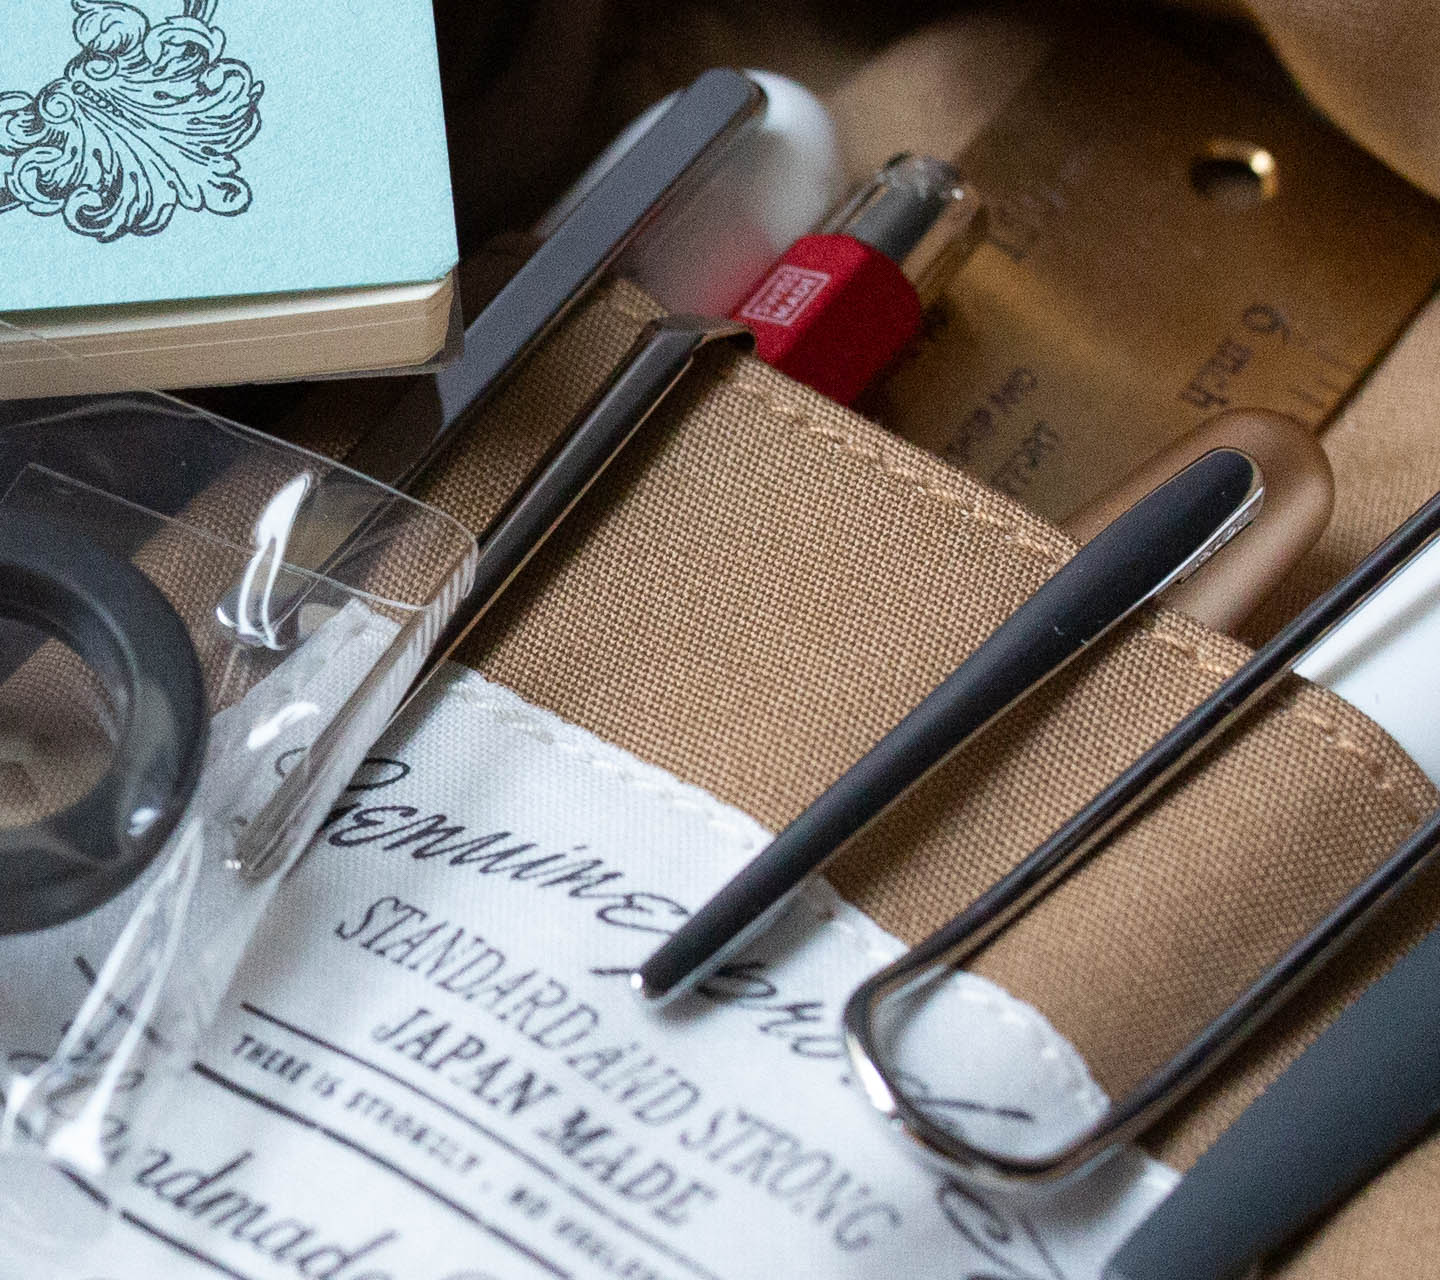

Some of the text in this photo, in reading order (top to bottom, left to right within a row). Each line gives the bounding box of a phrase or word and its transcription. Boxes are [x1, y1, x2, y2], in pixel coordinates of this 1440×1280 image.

[231, 1033, 310, 1088] THERE
[334, 895, 601, 1050] STANDARD
[679, 1106, 902, 1251] STRONG
[370, 1005, 717, 1227] JAPAN MADE
